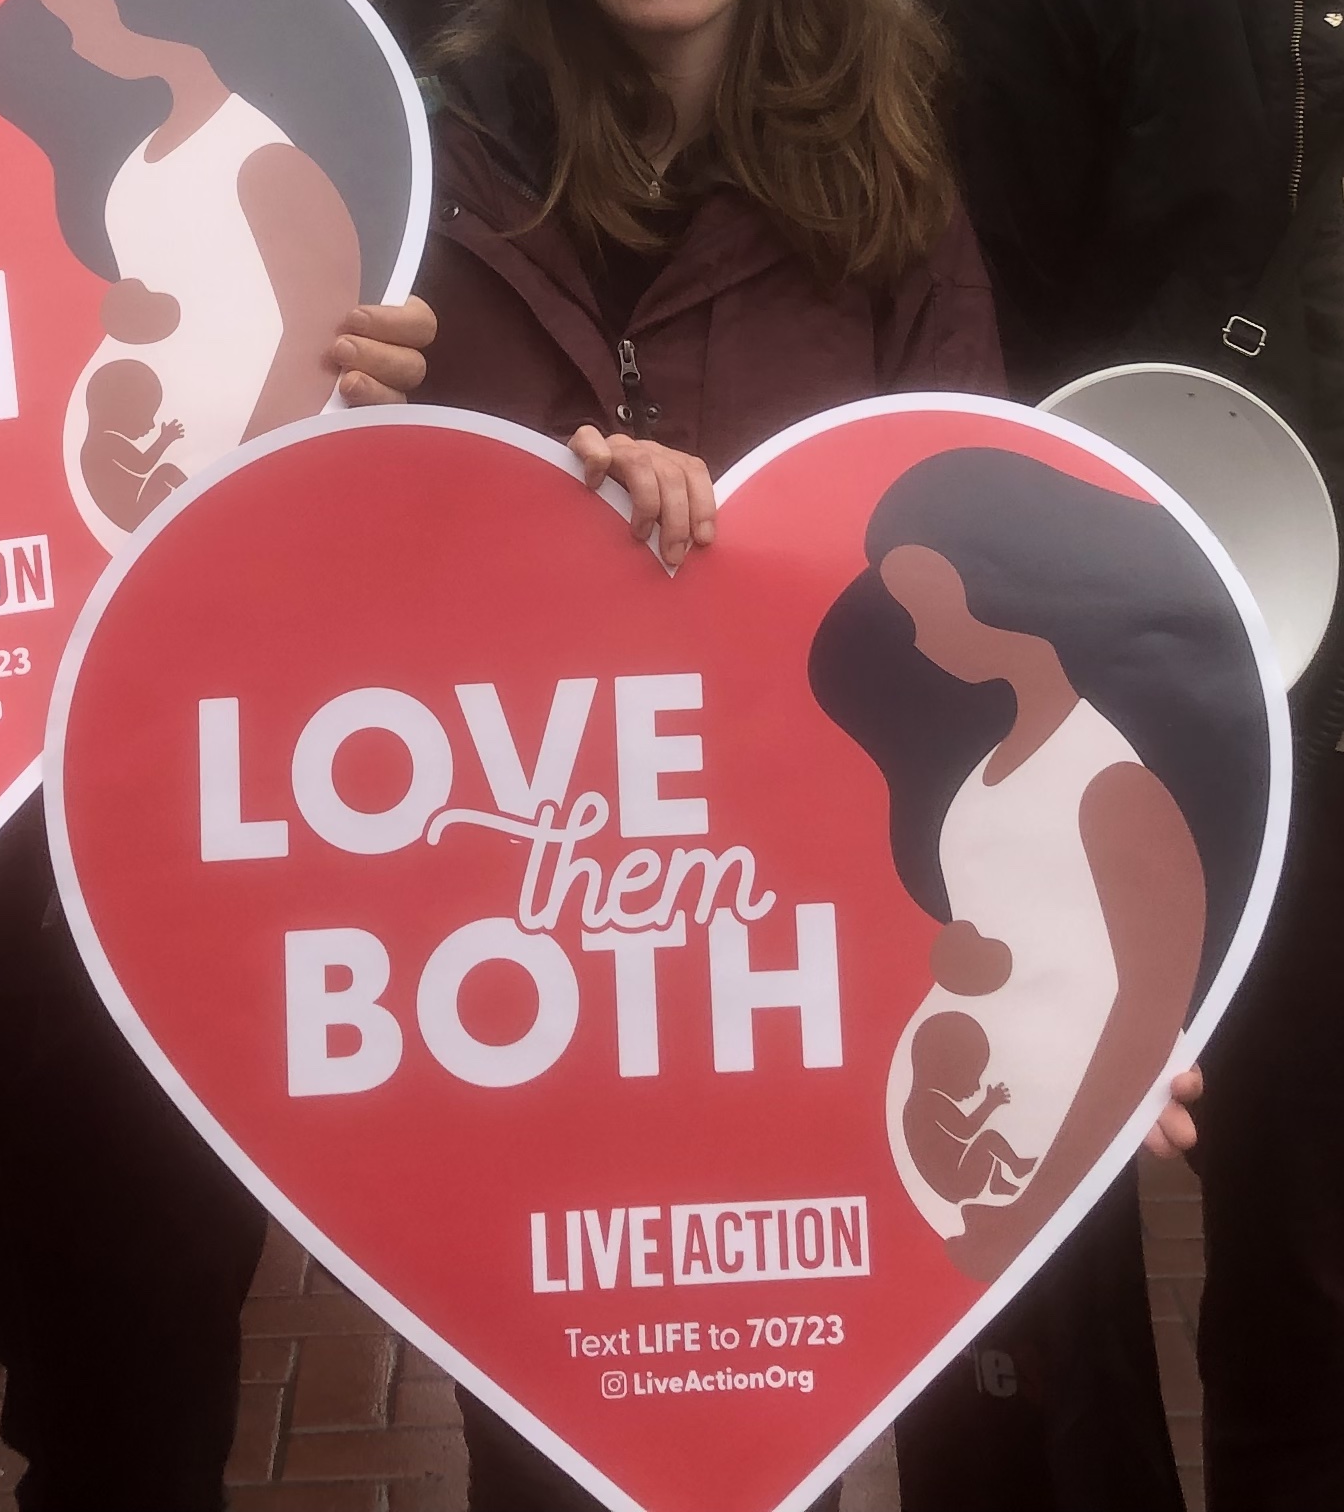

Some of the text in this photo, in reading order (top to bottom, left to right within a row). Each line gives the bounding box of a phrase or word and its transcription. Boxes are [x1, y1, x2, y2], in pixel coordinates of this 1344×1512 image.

[198, 672, 709, 862] LOVE
[427, 791, 777, 931] them
[284, 902, 844, 1098] BOTH
[530, 1205, 863, 1294] LIVE ACTION
[564, 1314, 846, 1358] Text LIFE to 70723
[633, 1364, 815, 1396] LiveActionOrg
